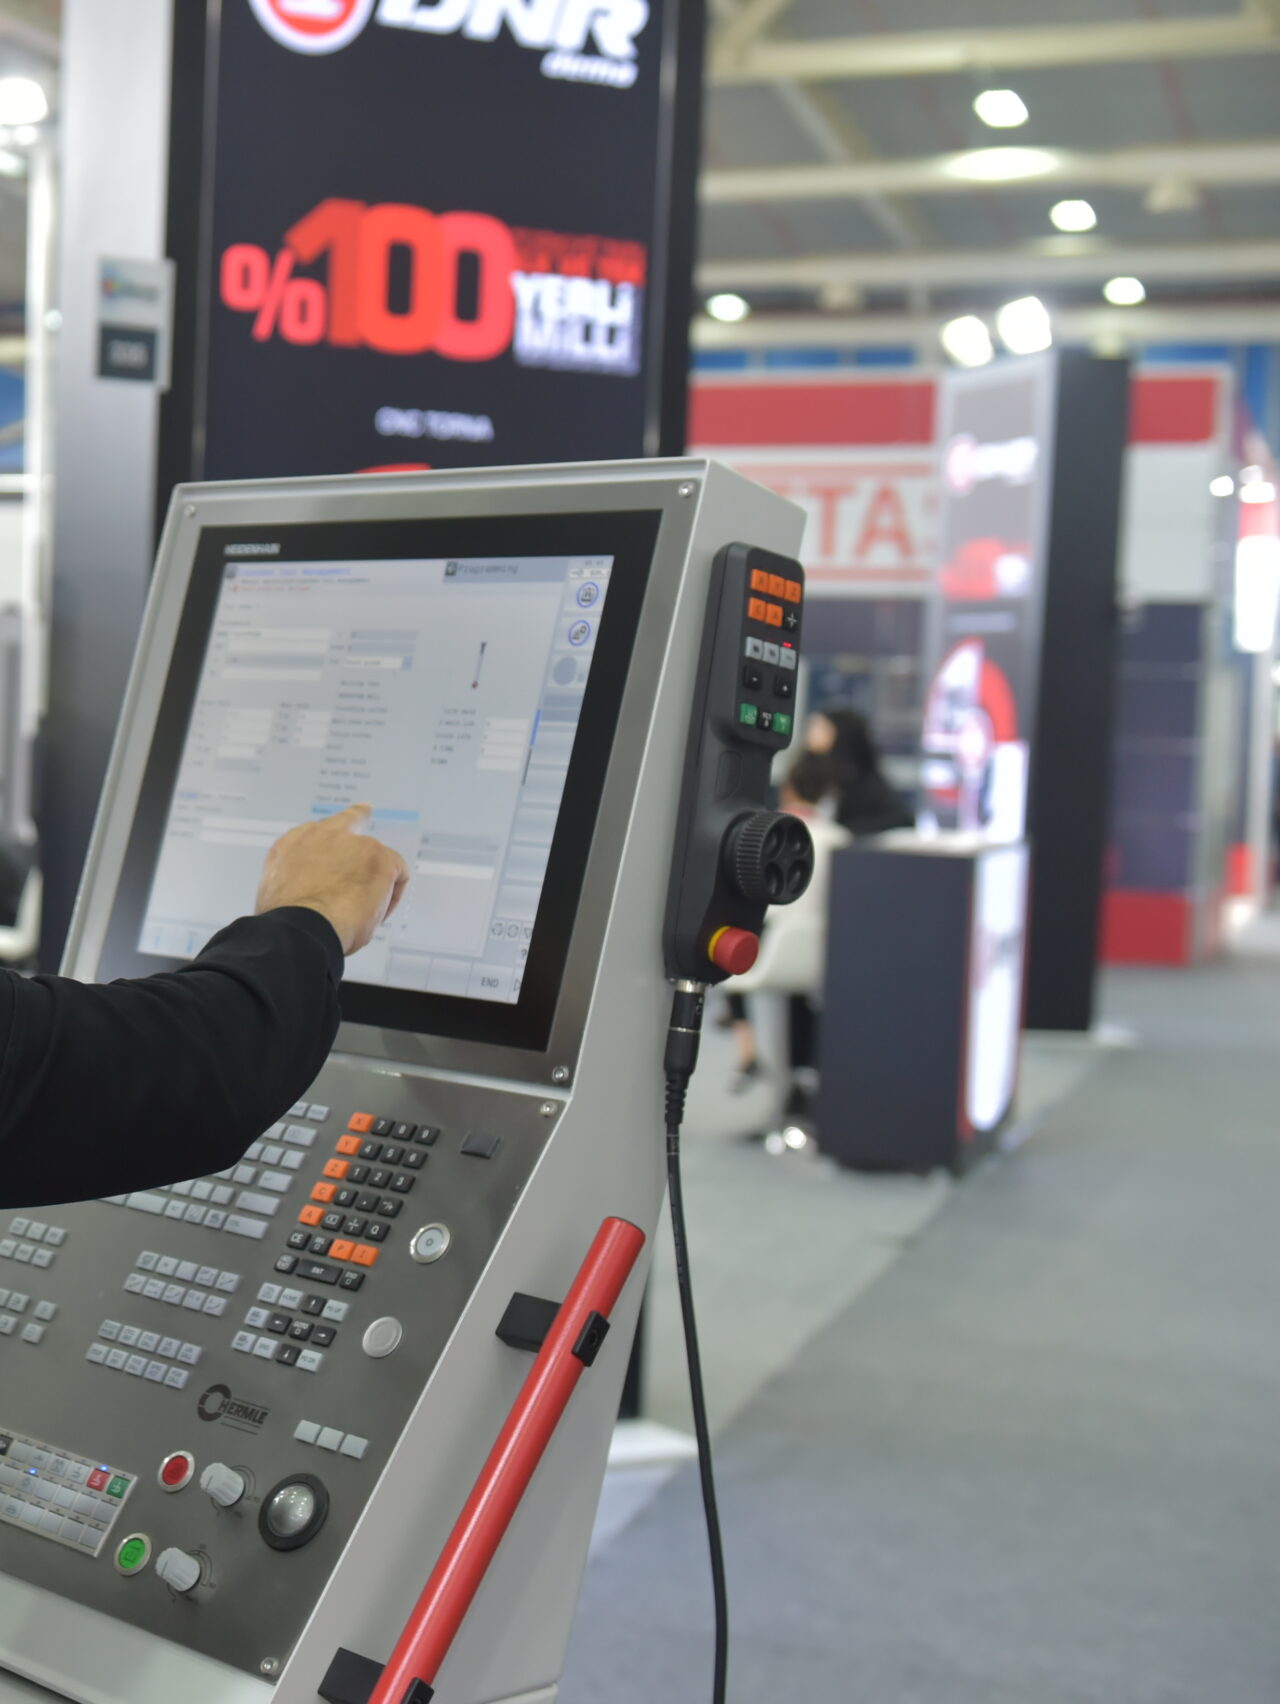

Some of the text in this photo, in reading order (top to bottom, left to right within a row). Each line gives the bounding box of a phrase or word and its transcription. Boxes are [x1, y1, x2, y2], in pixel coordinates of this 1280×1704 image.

[219, 196, 519, 362] %100
[458, 563, 519, 575] Programming
[480, 976, 500, 988] END
[377, 1120, 385, 1130] 7
[422, 1129, 429, 1139] 9
[364, 1145, 372, 1153] 4
[386, 1148, 394, 1158] 5
[409, 1153, 417, 1162] 6
[354, 1168, 360, 1177] 1
[373, 1172, 382, 1182] 2
[396, 1177, 405, 1186] 3
[290, 1232, 304, 1243] CE
